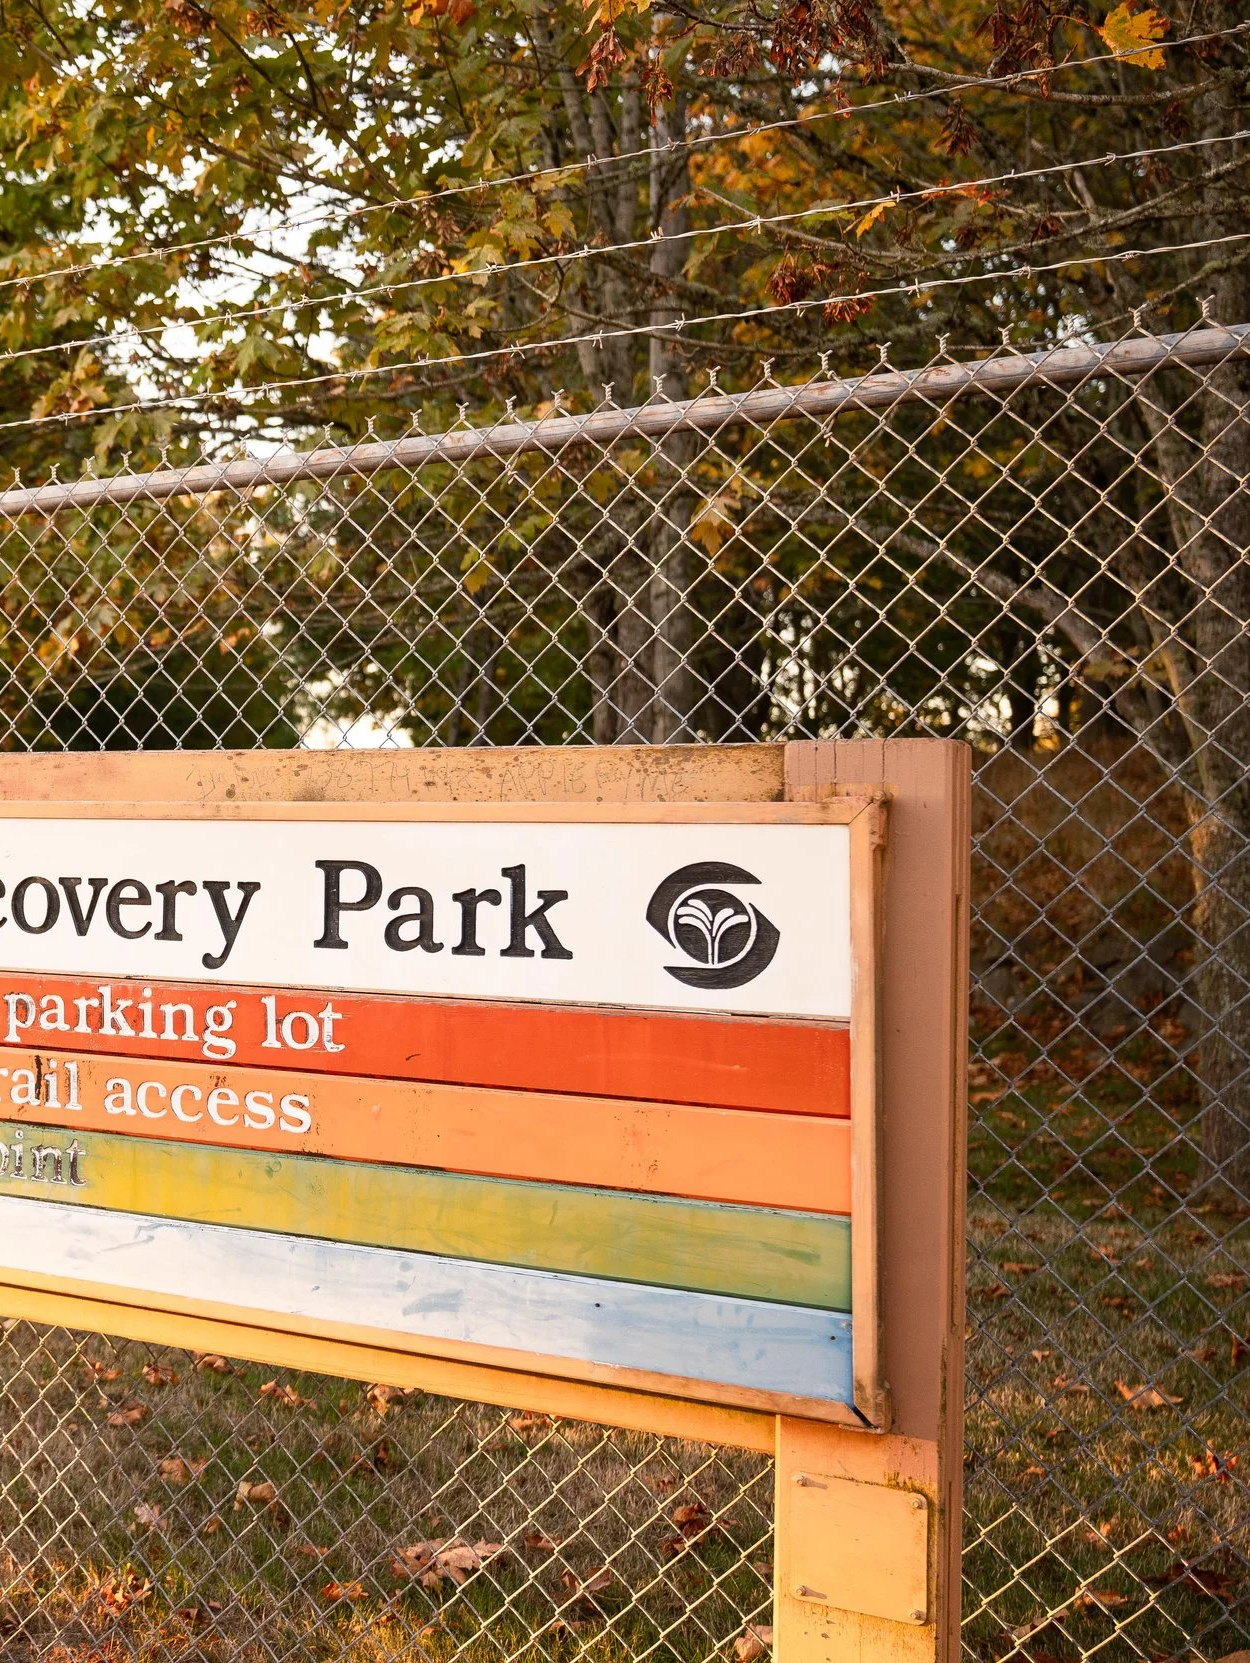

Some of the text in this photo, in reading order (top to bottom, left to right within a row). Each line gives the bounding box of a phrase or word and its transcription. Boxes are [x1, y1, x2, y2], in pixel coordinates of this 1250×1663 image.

[313, 859, 574, 960] Park
[3, 984, 237, 1059] parking
[259, 995, 346, 1053] lot
[104, 1075, 313, 1134] access
